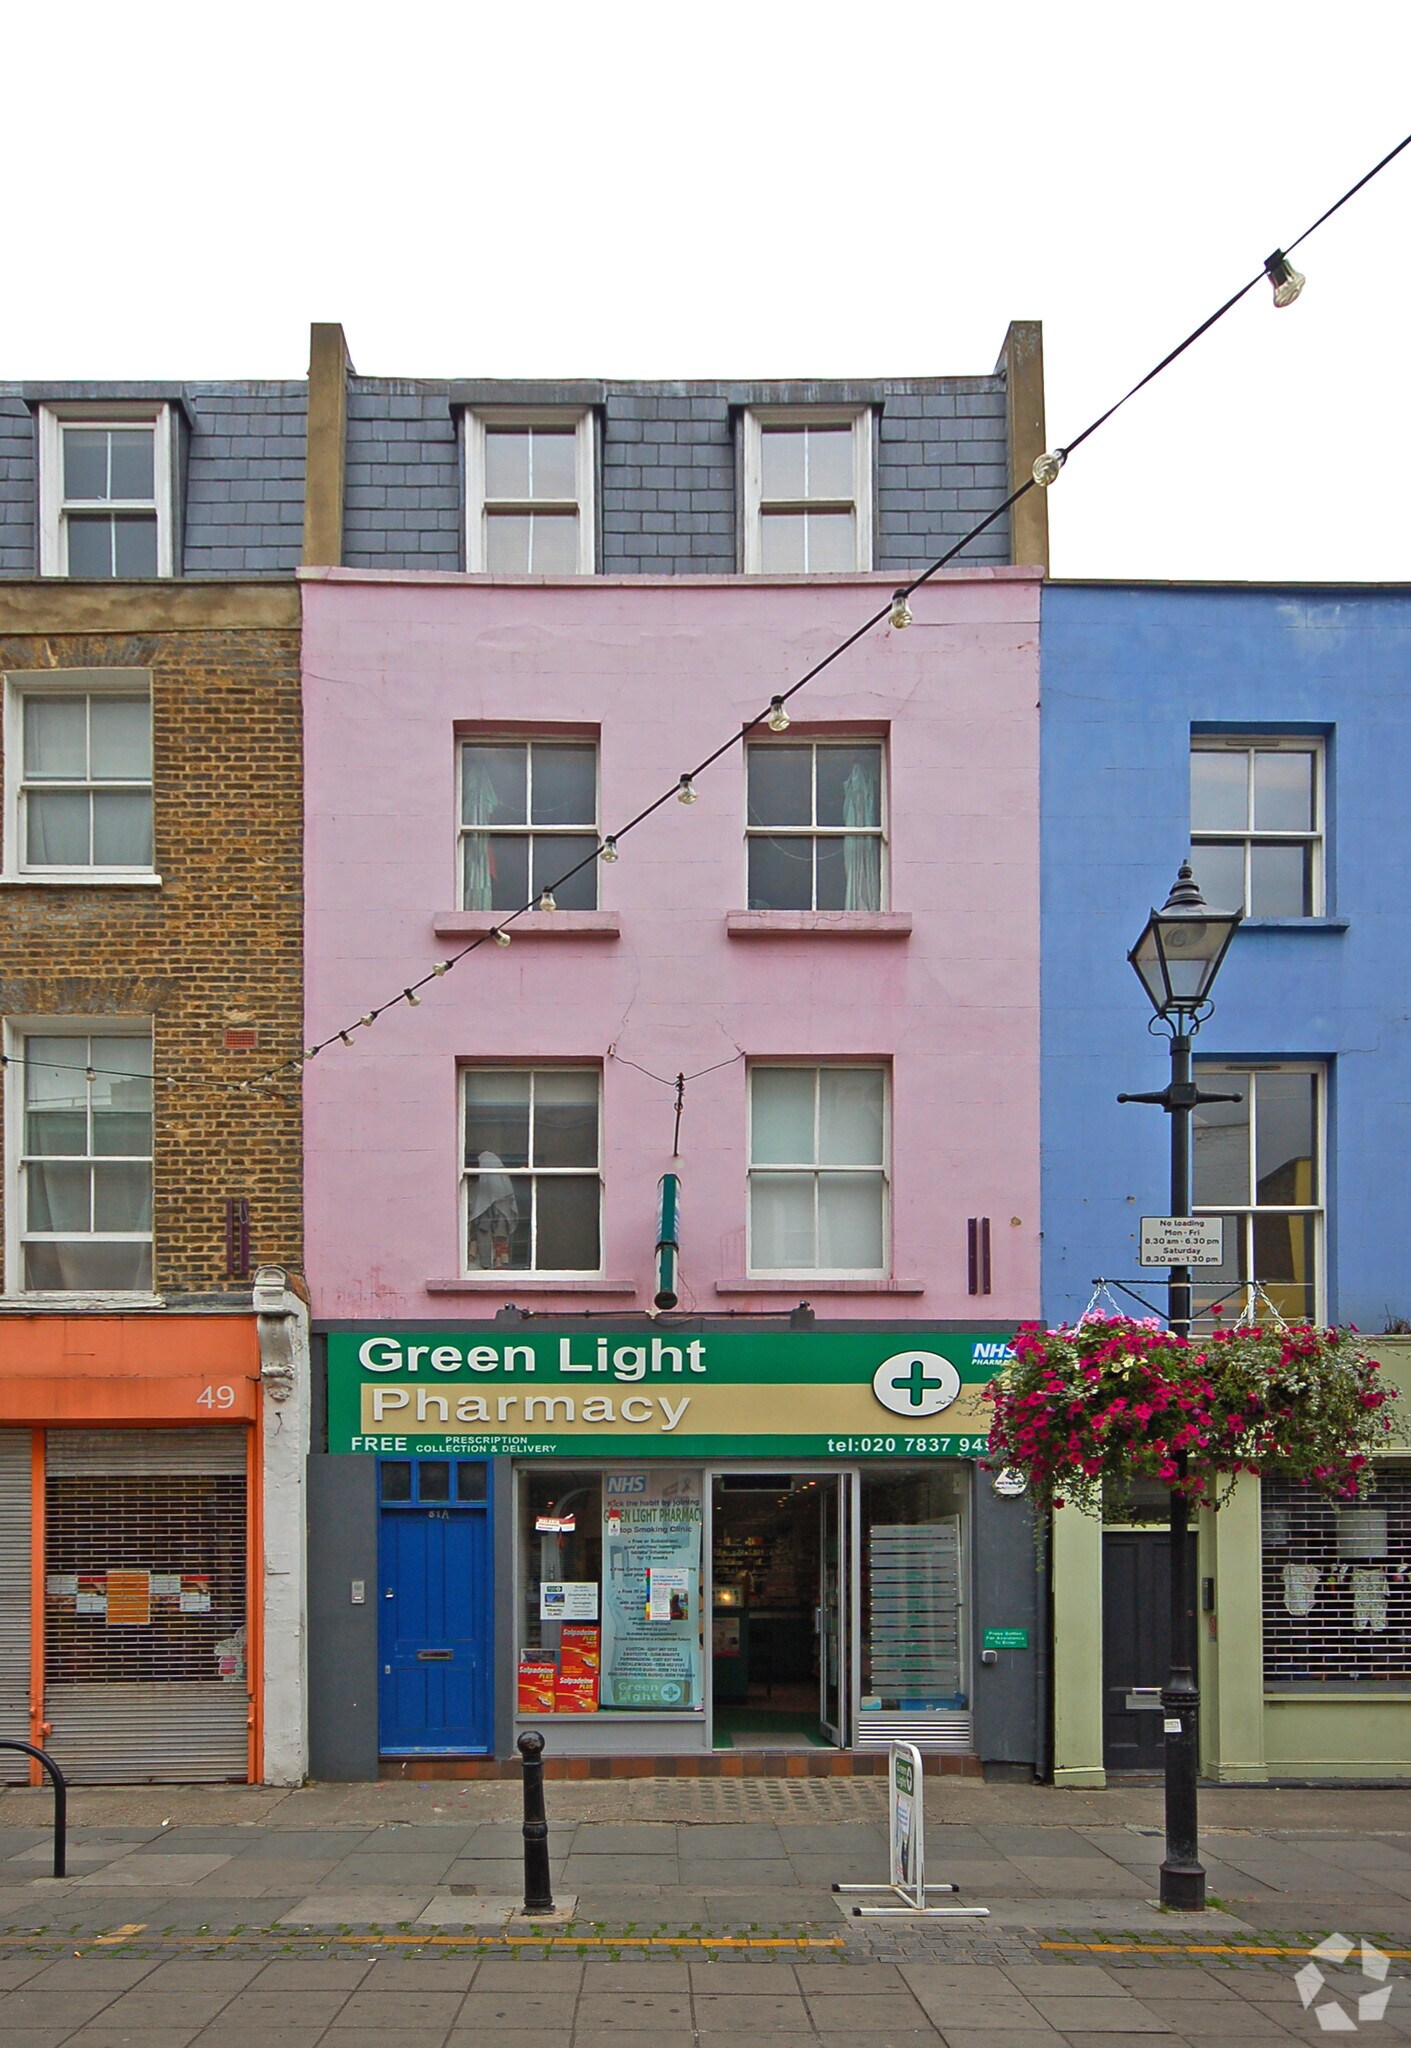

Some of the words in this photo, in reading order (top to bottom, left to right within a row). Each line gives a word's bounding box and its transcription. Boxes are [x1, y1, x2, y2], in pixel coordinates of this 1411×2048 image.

[358, 1337, 537, 1373] Green
[558, 1337, 707, 1381] Light
[196, 1386, 235, 1410] 49
[371, 1388, 692, 1431] Pharmacy
[351, 1437, 407, 1452] FREE
[827, 1437, 896, 1452] tel:020
[905, 1437, 951, 1452] 7837
[959, 1437, 989, 1452] 94
[608, 1477, 645, 1492] NHS
[661, 1499, 671, 1507] by
[673, 1499, 700, 1507] joining
[604, 1509, 631, 1523] GEN
[632, 1509, 657, 1523] LIGHT
[620, 1526, 632, 1534] top
[634, 1526, 668, 1534] Smoking
[670, 1526, 693, 1534] Clinic
[618, 1682, 658, 1691] Green
[619, 1692, 658, 1702] Light
